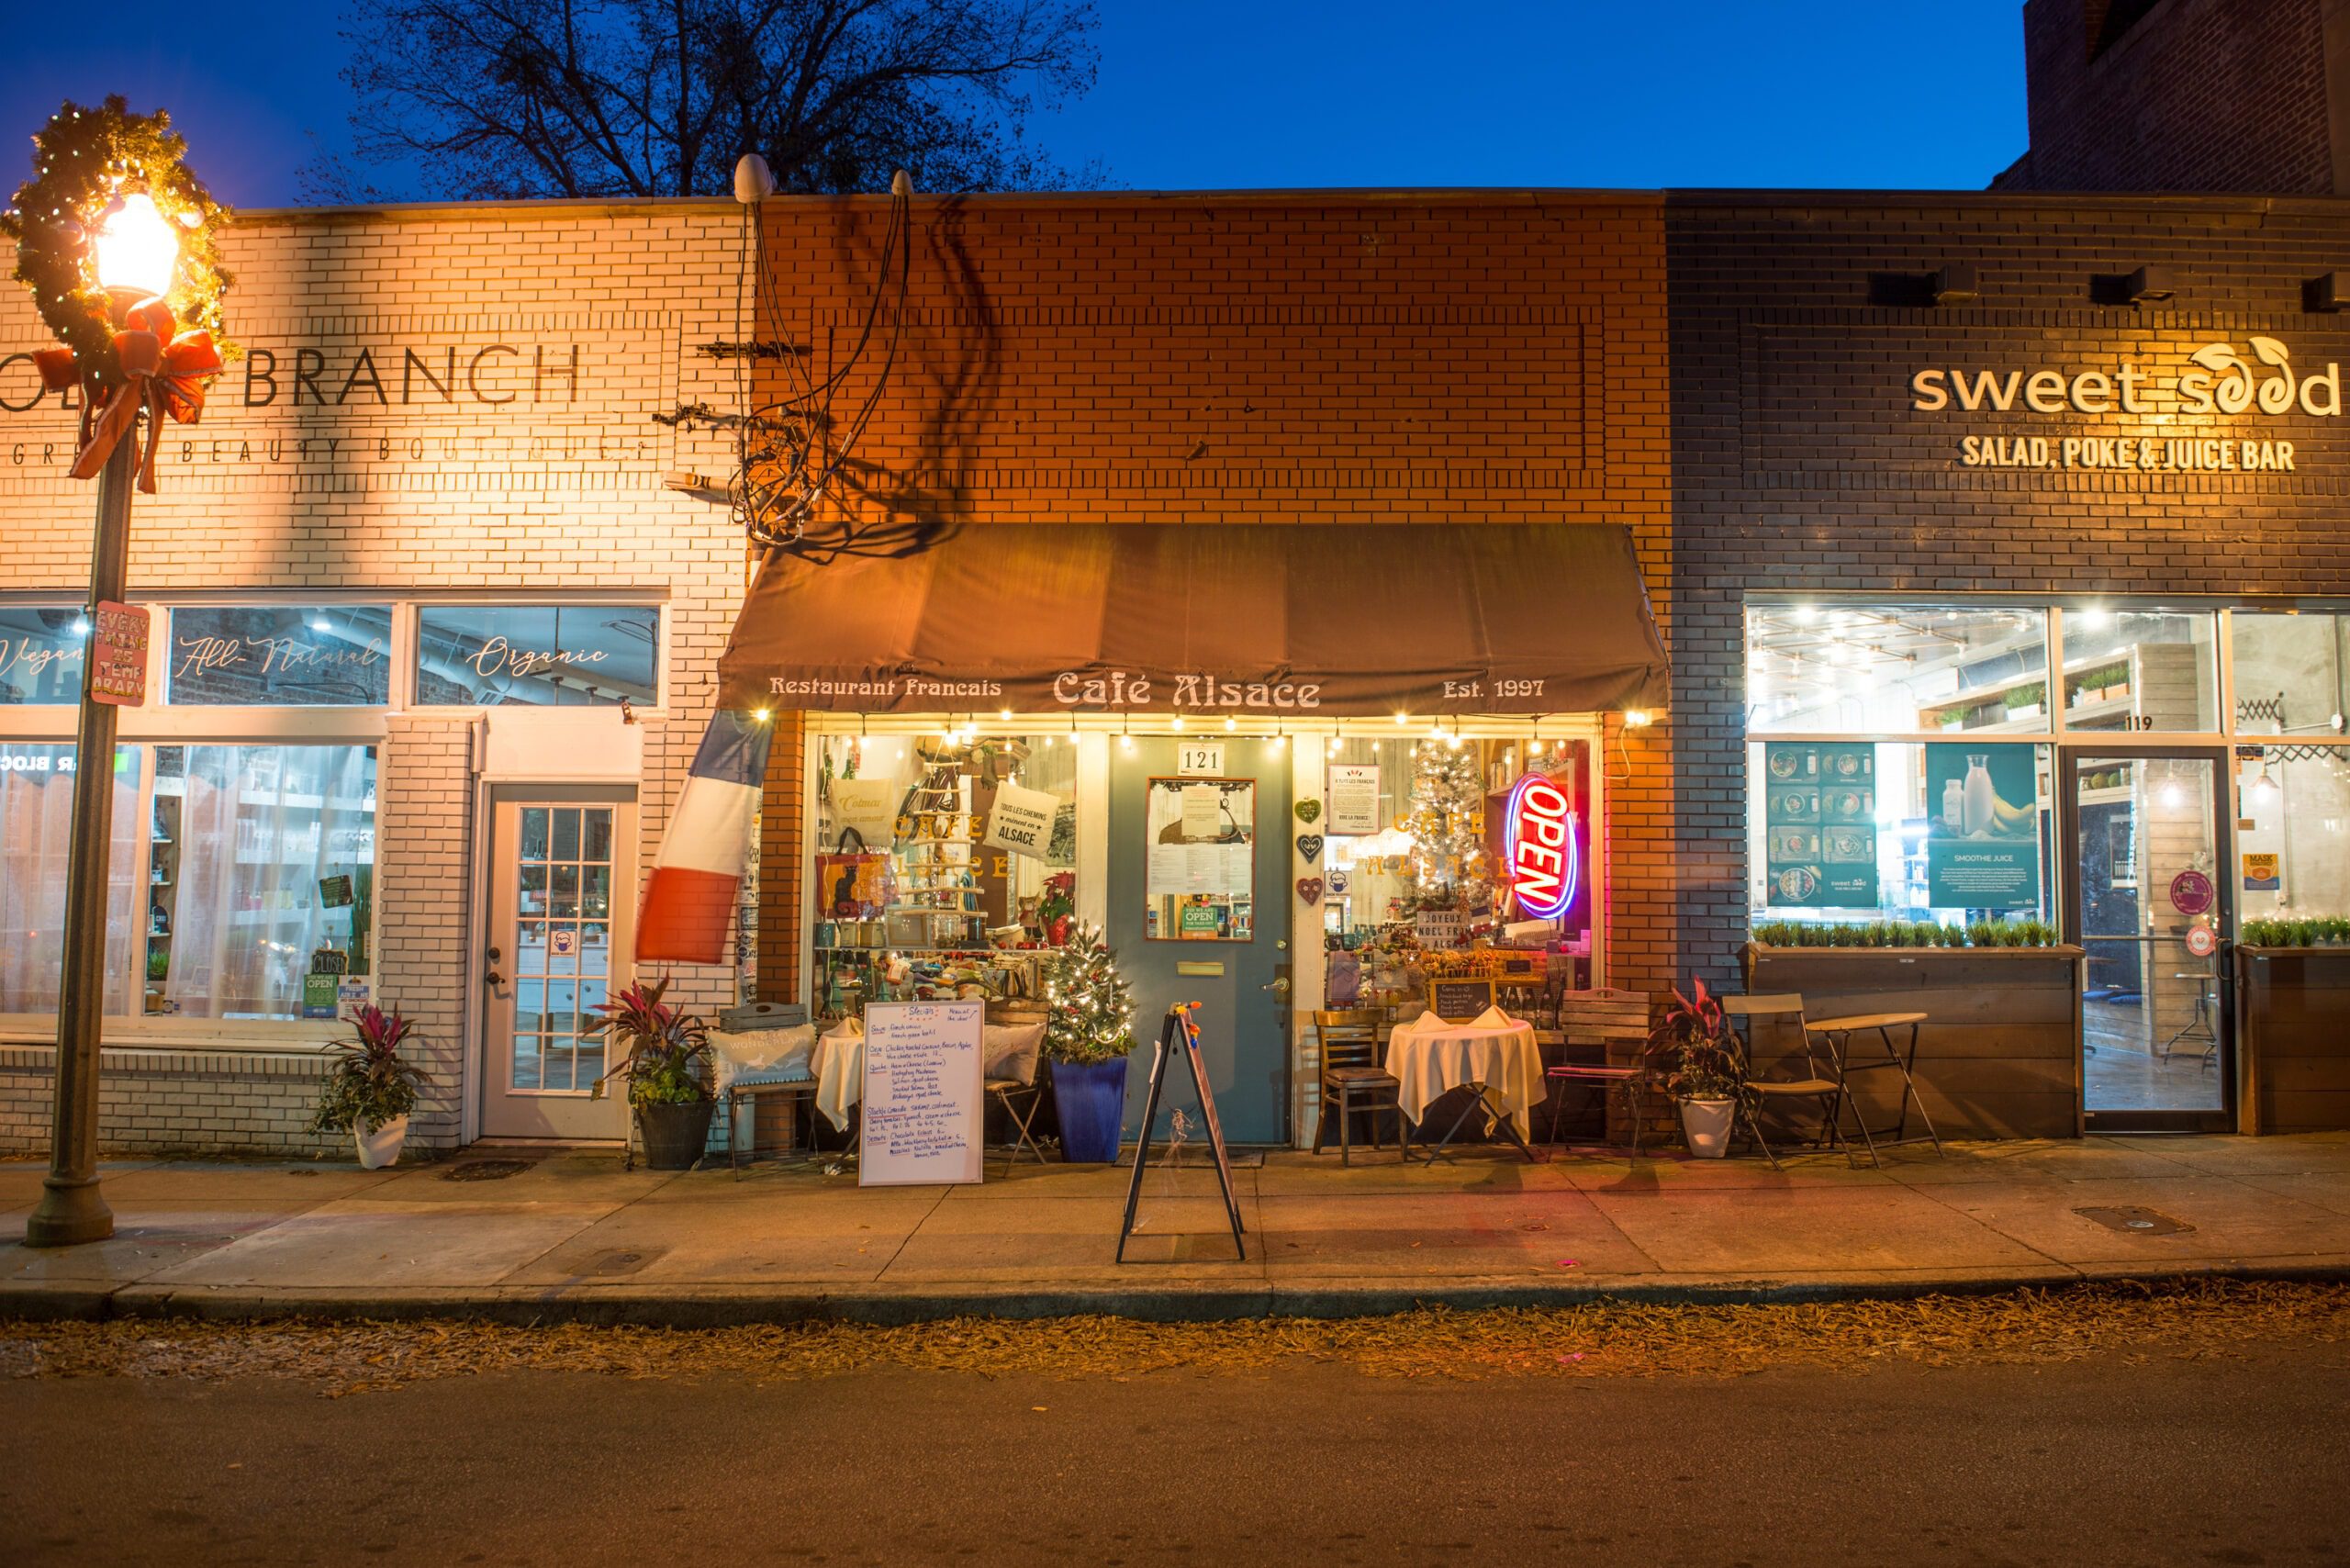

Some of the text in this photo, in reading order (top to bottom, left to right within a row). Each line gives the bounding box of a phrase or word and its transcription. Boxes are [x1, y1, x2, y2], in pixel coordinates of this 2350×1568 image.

[243, 344, 579, 407] BRANCH
[1912, 364, 2149, 414] sweet
[182, 440, 342, 463] BEAUTY
[1963, 435, 2295, 471] SALAD, POKE & JUICE BAR
[96, 610, 147, 633] EVERY
[0, 637, 84, 677] Vegan
[246, 636, 383, 674] Natural
[465, 635, 610, 678] Organic
[769, 677, 1002, 697] Restaurant Francais
[1053, 671, 1320, 708] Café Alsace
[1443, 679, 1544, 699] Est. 1997
[2126, 716, 2153, 731] 119
[1185, 751, 1218, 769] 121
[838, 794, 881, 812] Colmar
[1000, 802, 1047, 822] TOUS LES CHEMINS
[998, 825, 1036, 846] ALSACE
[1514, 785, 1569, 904] OPEN
[1953, 854, 1992, 862] SMOOTHIE
[1185, 912, 1214, 922] OPEN
[1426, 913, 1460, 924] JOYEUX
[1419, 926, 1442, 935] NOEL
[307, 980, 334, 989] OPEN
